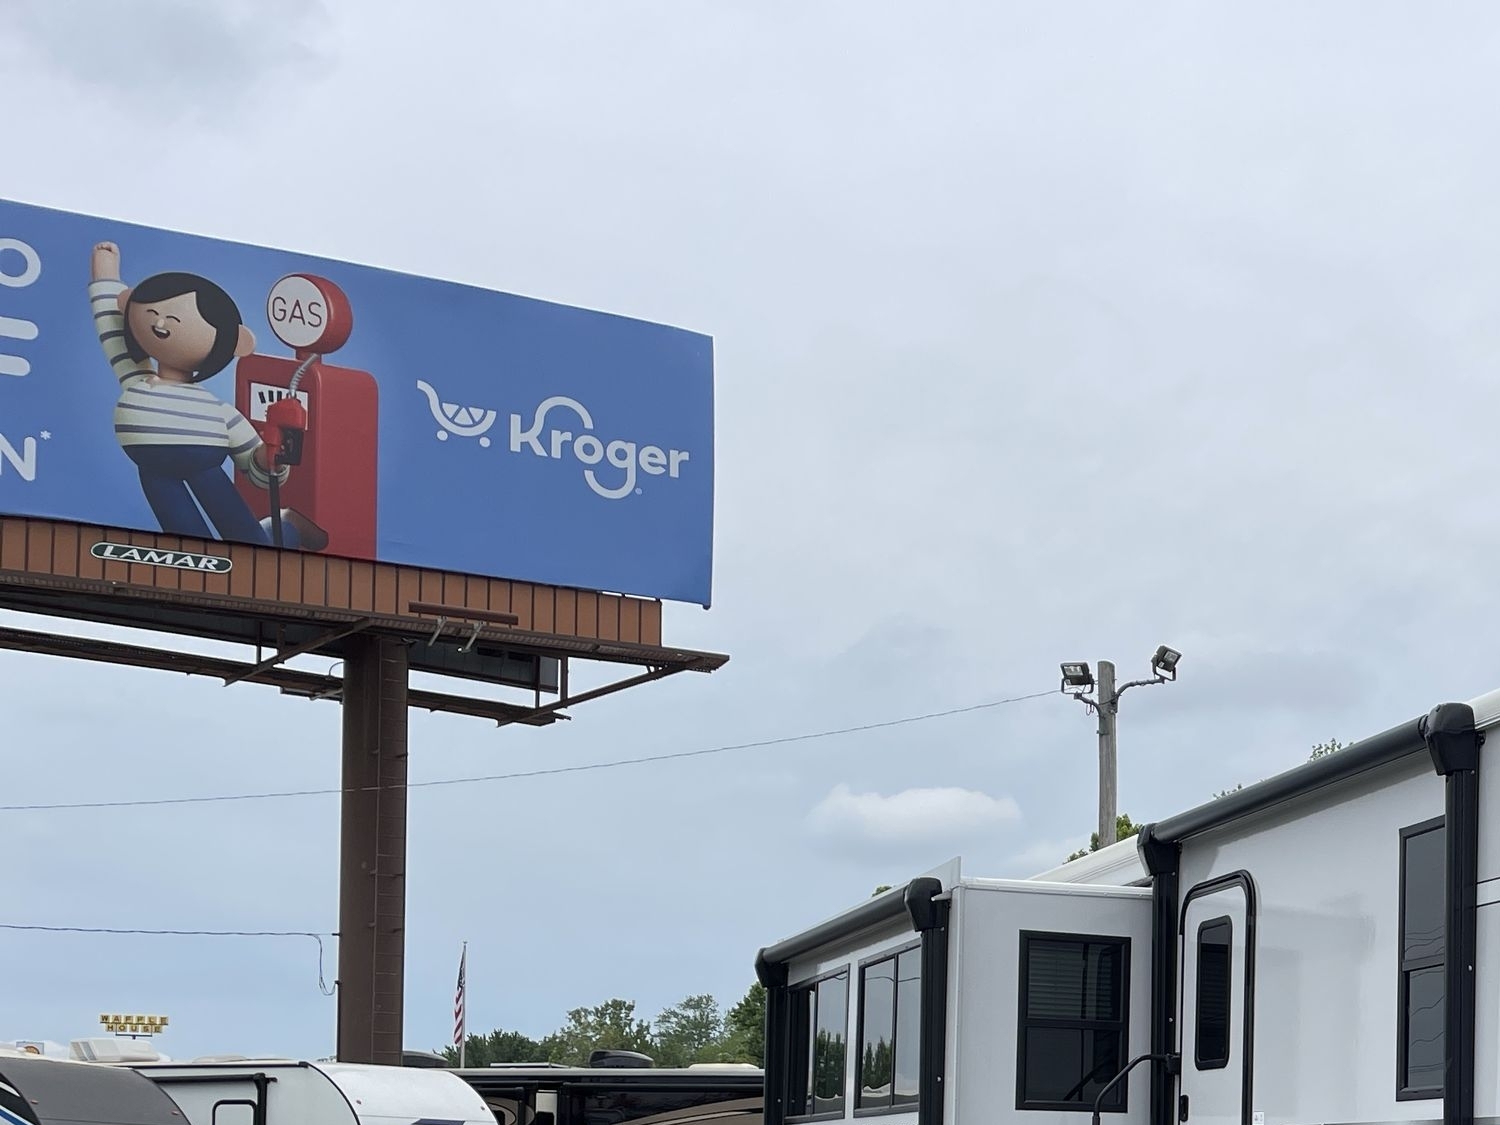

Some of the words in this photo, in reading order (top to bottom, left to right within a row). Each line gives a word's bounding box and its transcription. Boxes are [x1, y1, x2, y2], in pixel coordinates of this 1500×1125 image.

[272, 296, 323, 328] GAS
[510, 396, 690, 499] Kroger
[102, 545, 219, 571] LAMAR
[101, 1015, 168, 1025] WAFFLE
[107, 1024, 162, 1034] HOUSE
